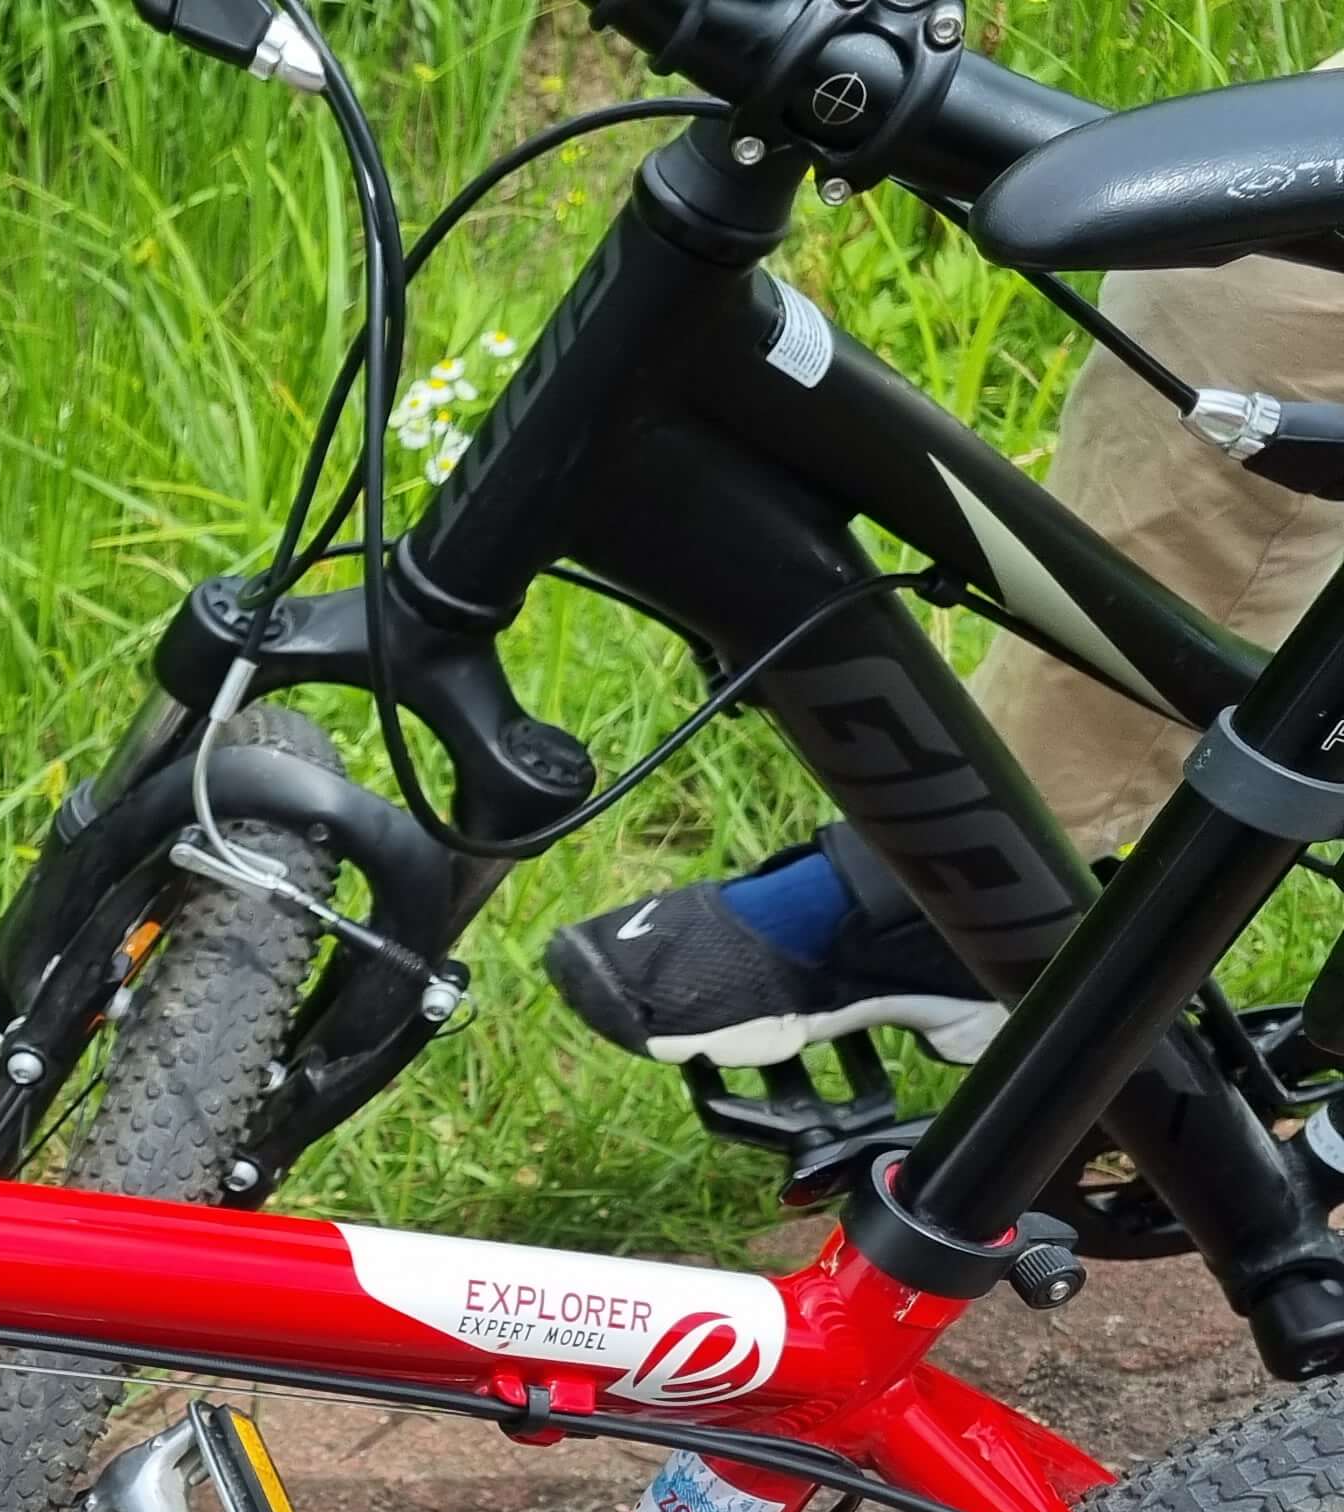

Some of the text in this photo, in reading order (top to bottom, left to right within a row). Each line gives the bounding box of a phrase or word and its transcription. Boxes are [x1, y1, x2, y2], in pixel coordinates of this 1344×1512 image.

[465, 1278, 653, 1334] EXPLORER
[457, 1316, 608, 1351] EXPERT MODEL
